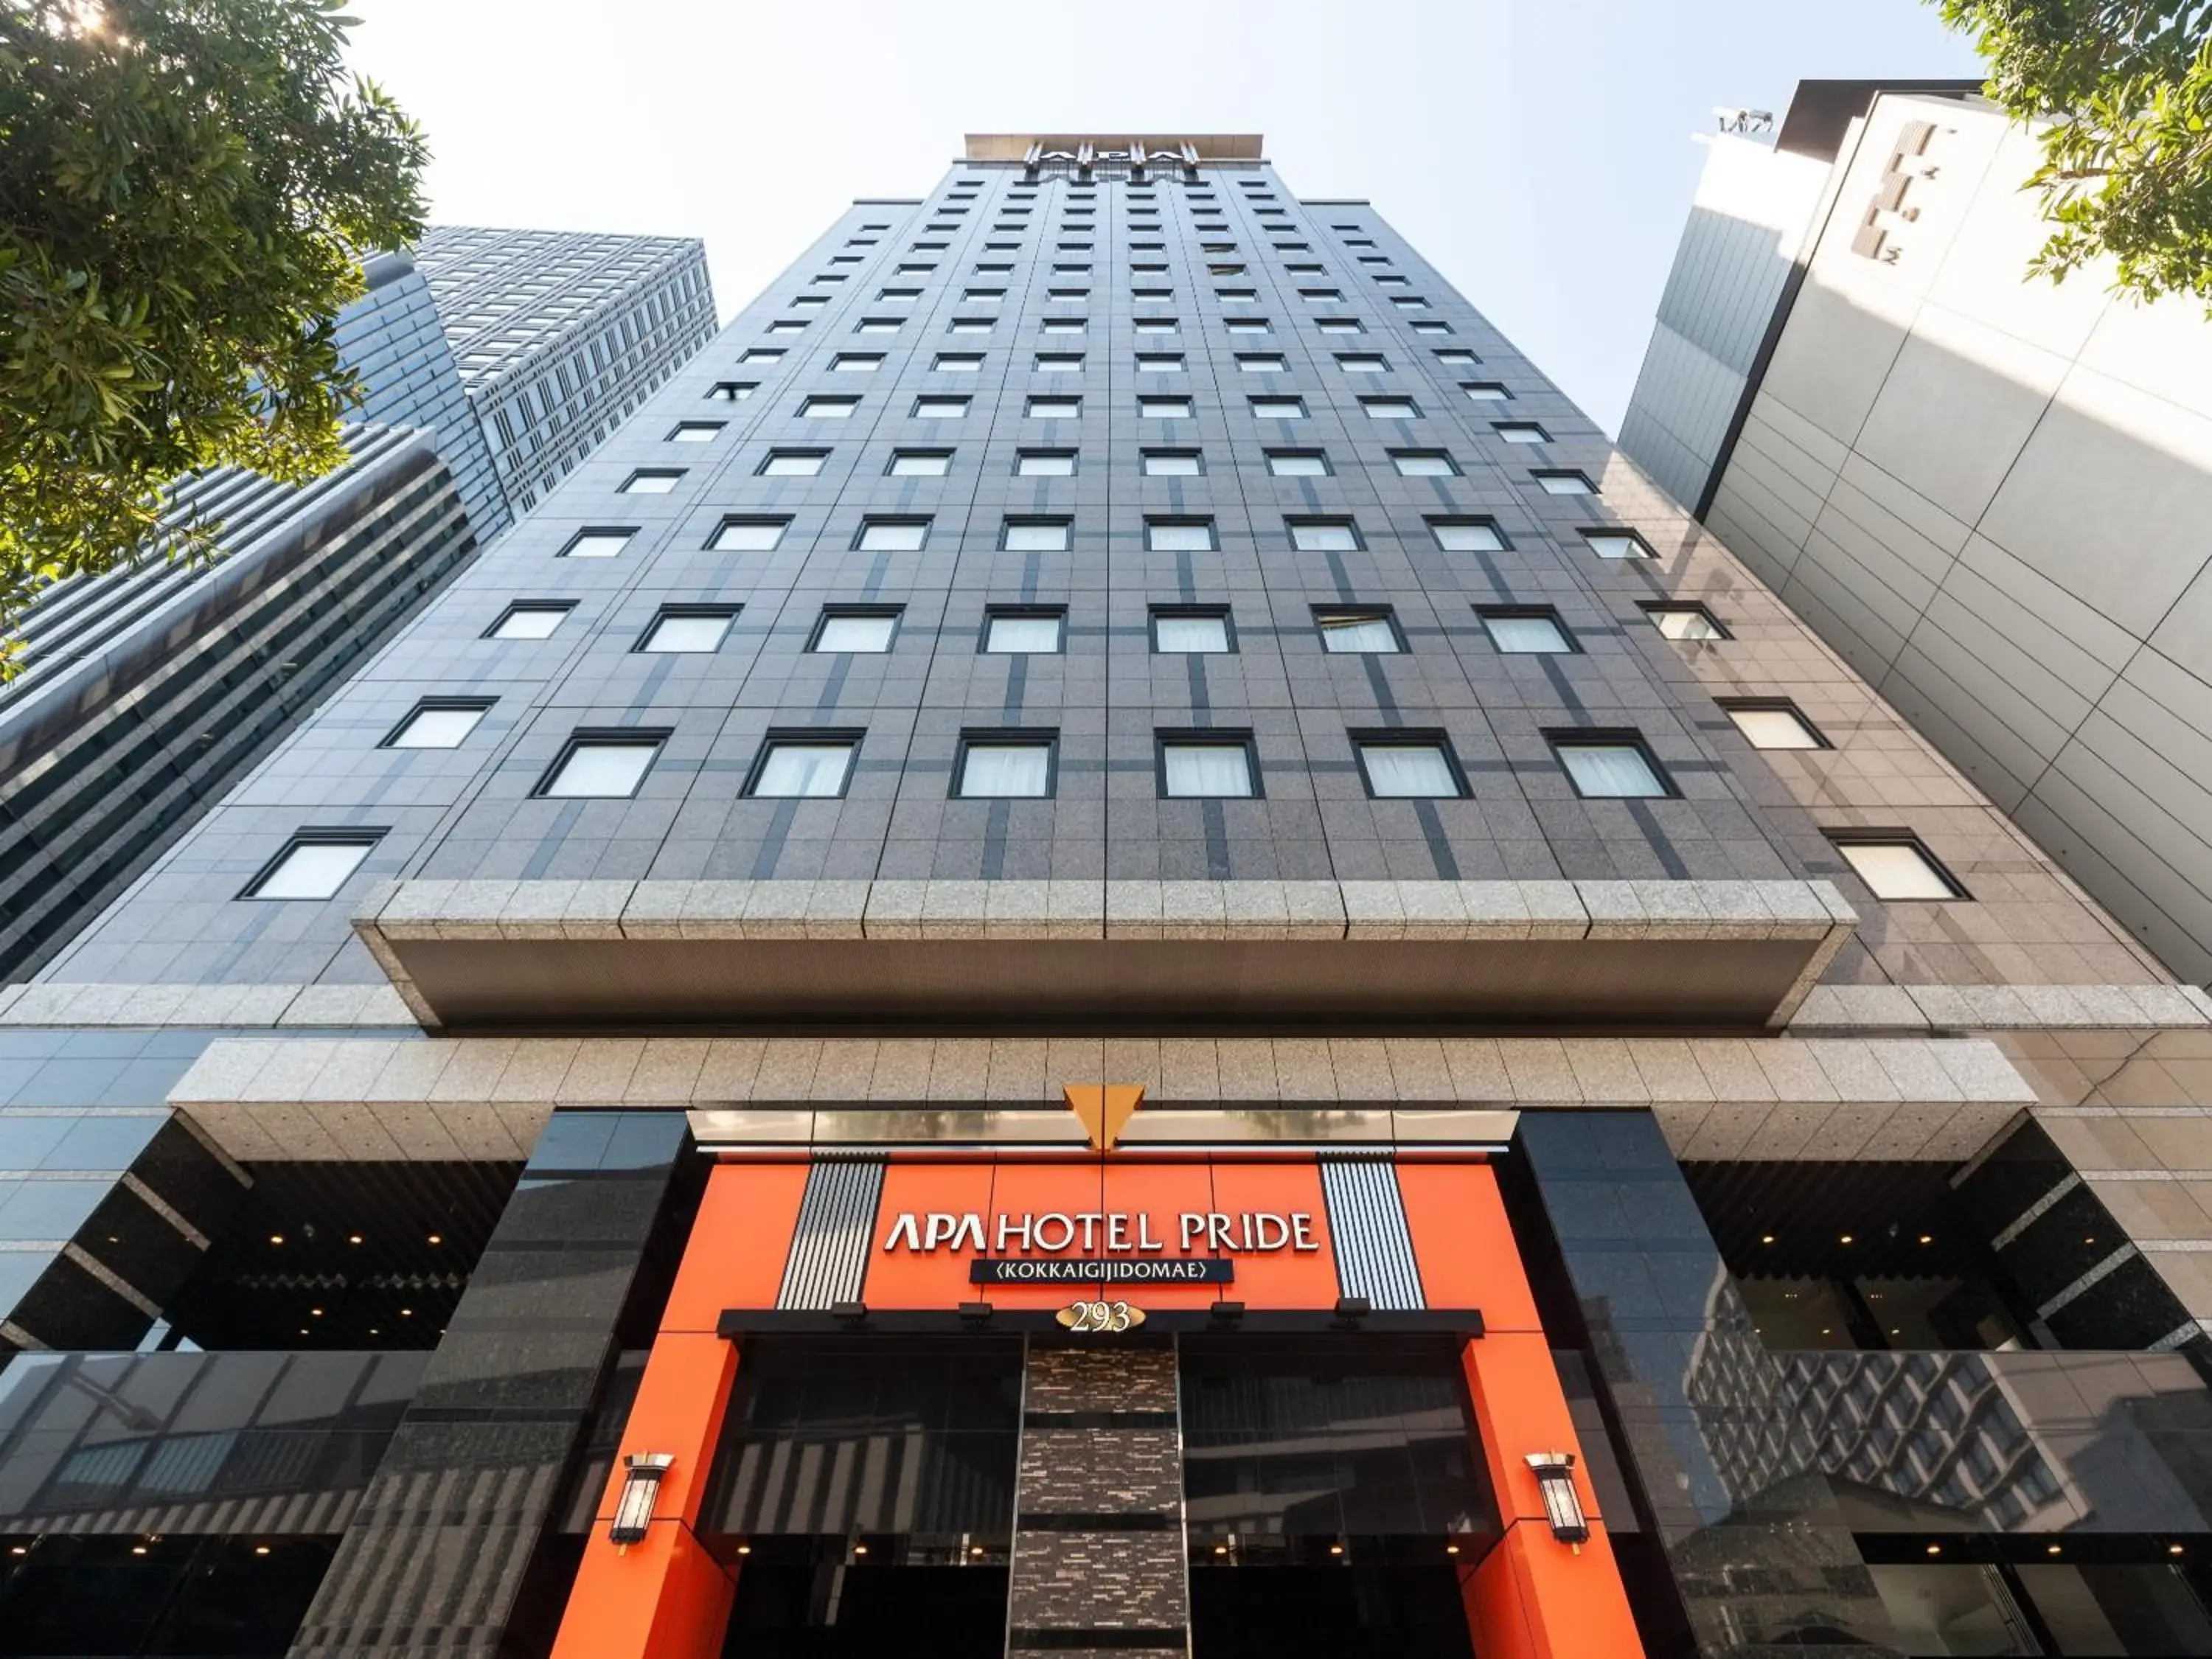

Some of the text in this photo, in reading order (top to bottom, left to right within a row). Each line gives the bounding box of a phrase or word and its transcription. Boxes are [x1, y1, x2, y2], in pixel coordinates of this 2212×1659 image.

[884, 1213, 1320, 1251] APA HOTEL PRIDE
[1070, 1301, 1130, 1332] 293
